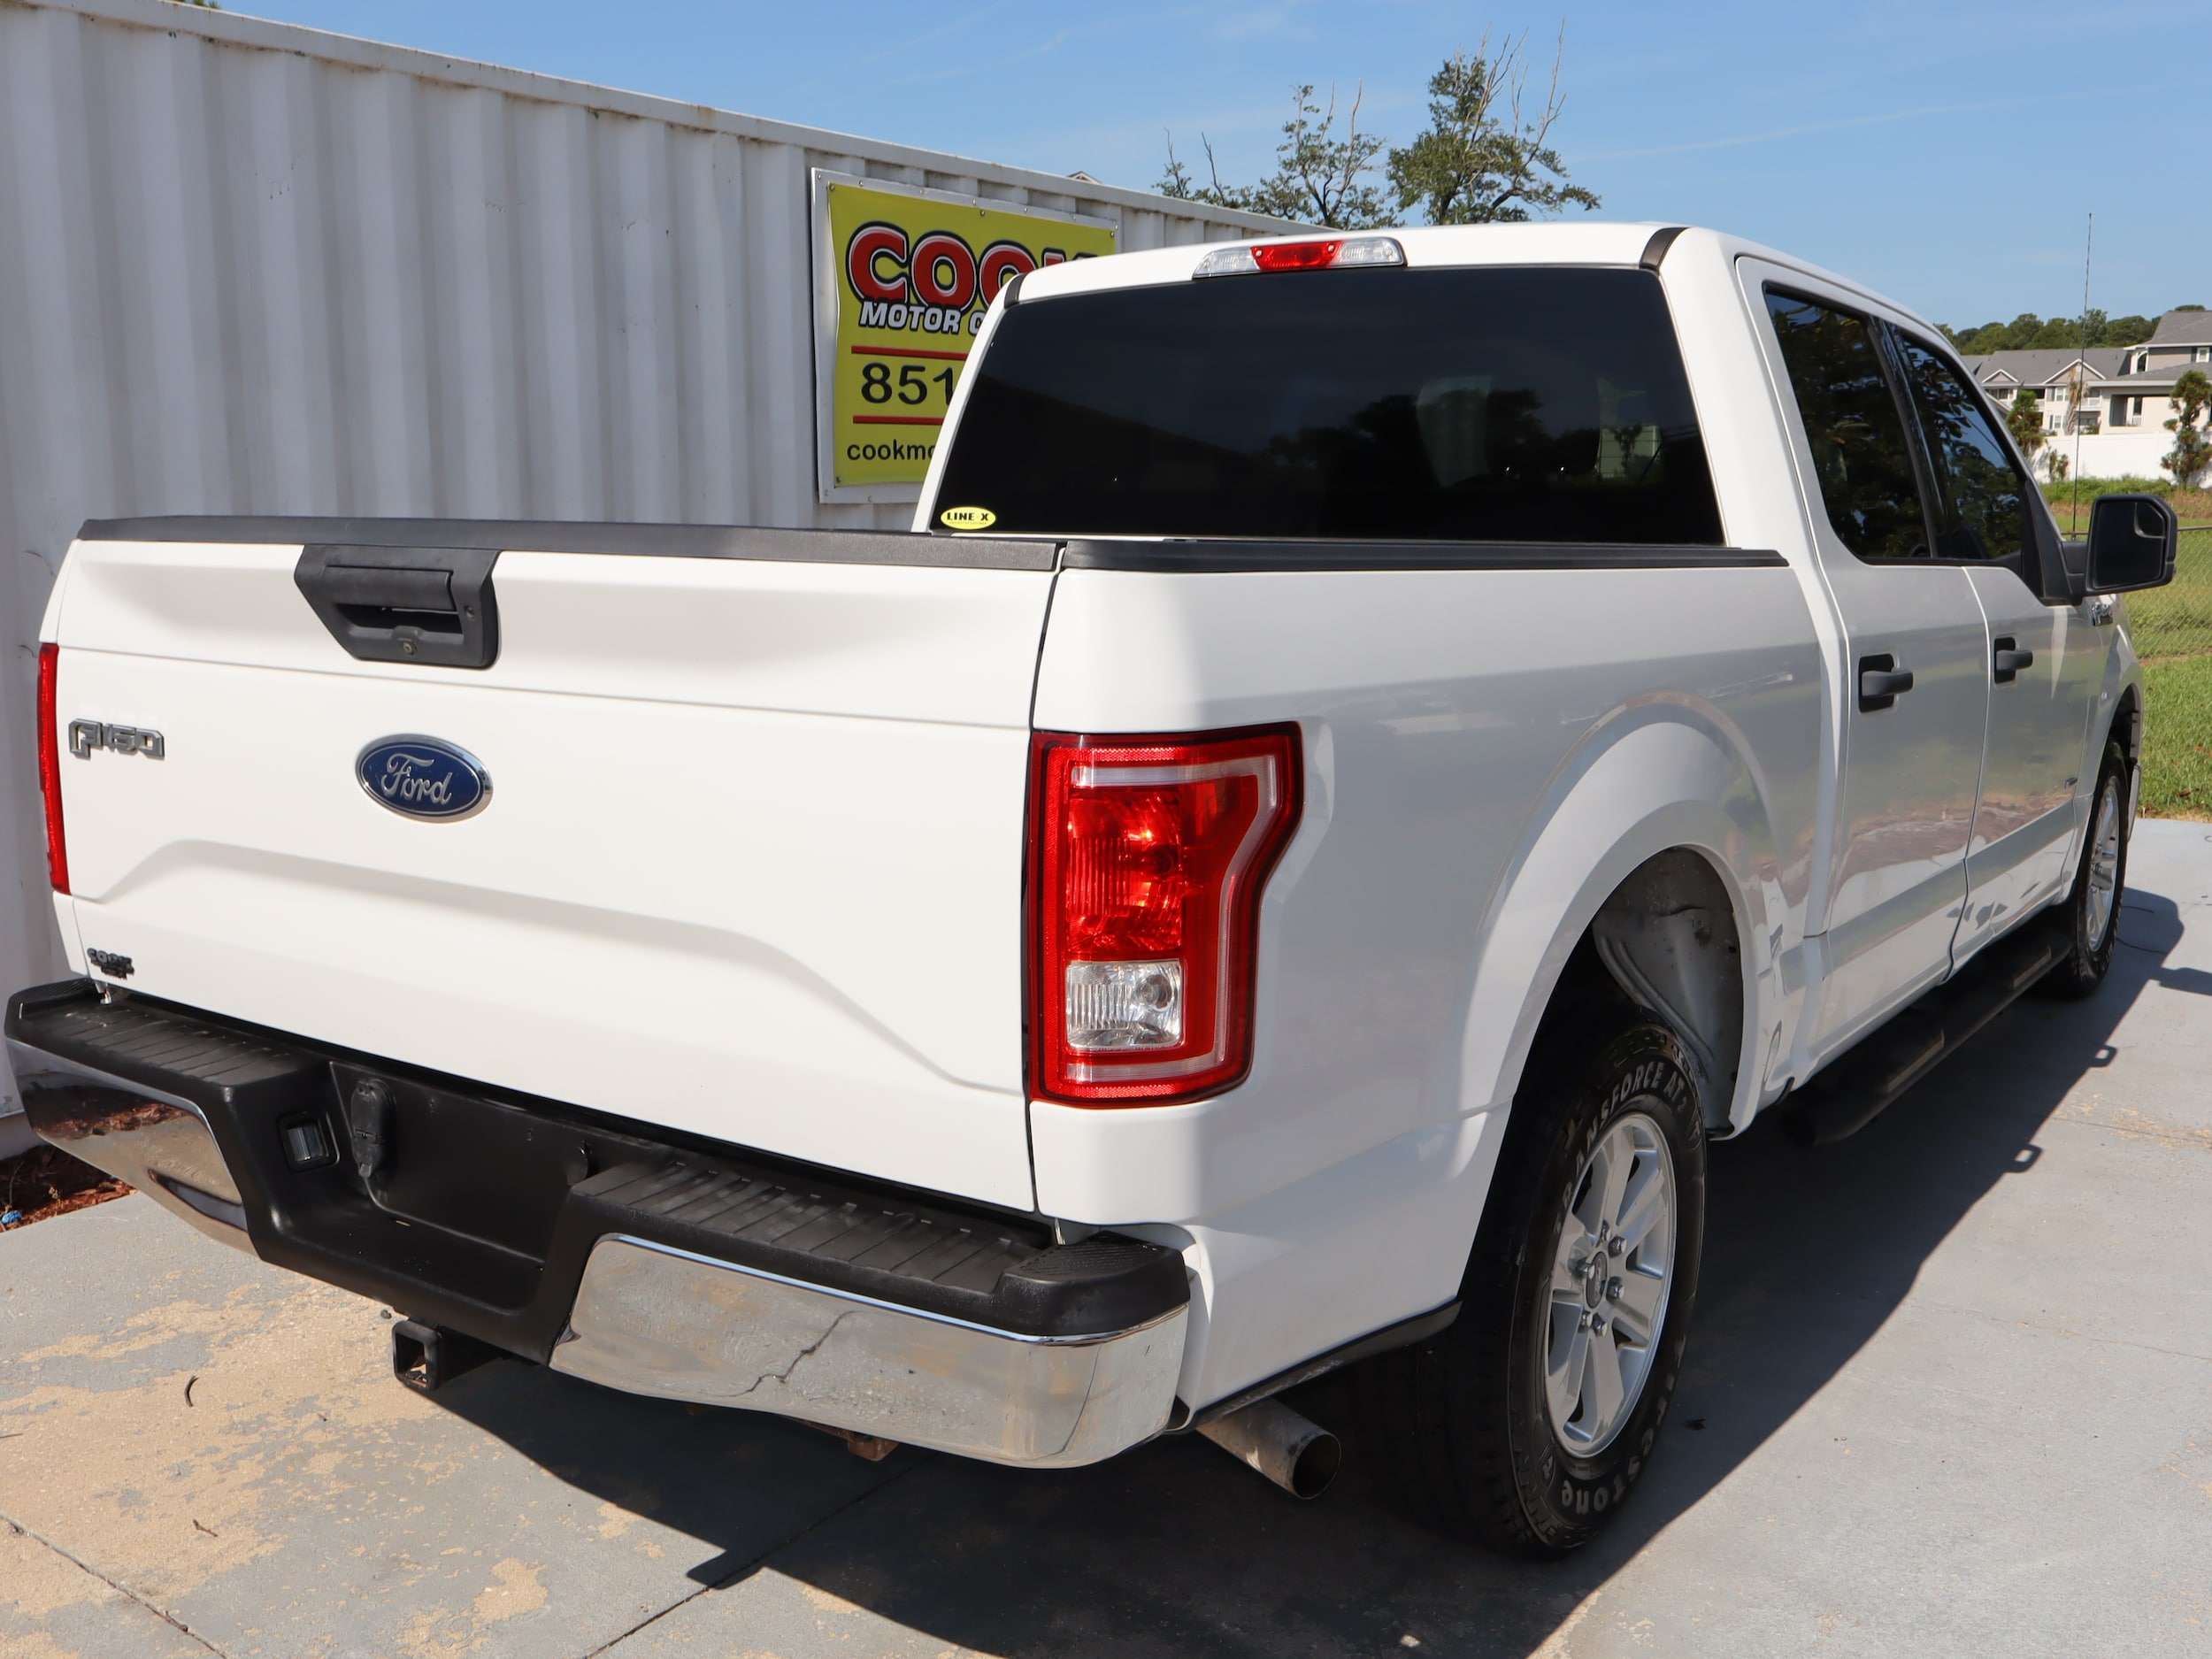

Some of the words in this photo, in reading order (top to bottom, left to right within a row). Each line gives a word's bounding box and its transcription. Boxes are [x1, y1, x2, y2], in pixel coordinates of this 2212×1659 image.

[846, 220, 1098, 317] COO
[859, 301, 962, 334] MOTOR
[861, 362, 954, 405] 851
[380, 753, 453, 804] Ford
